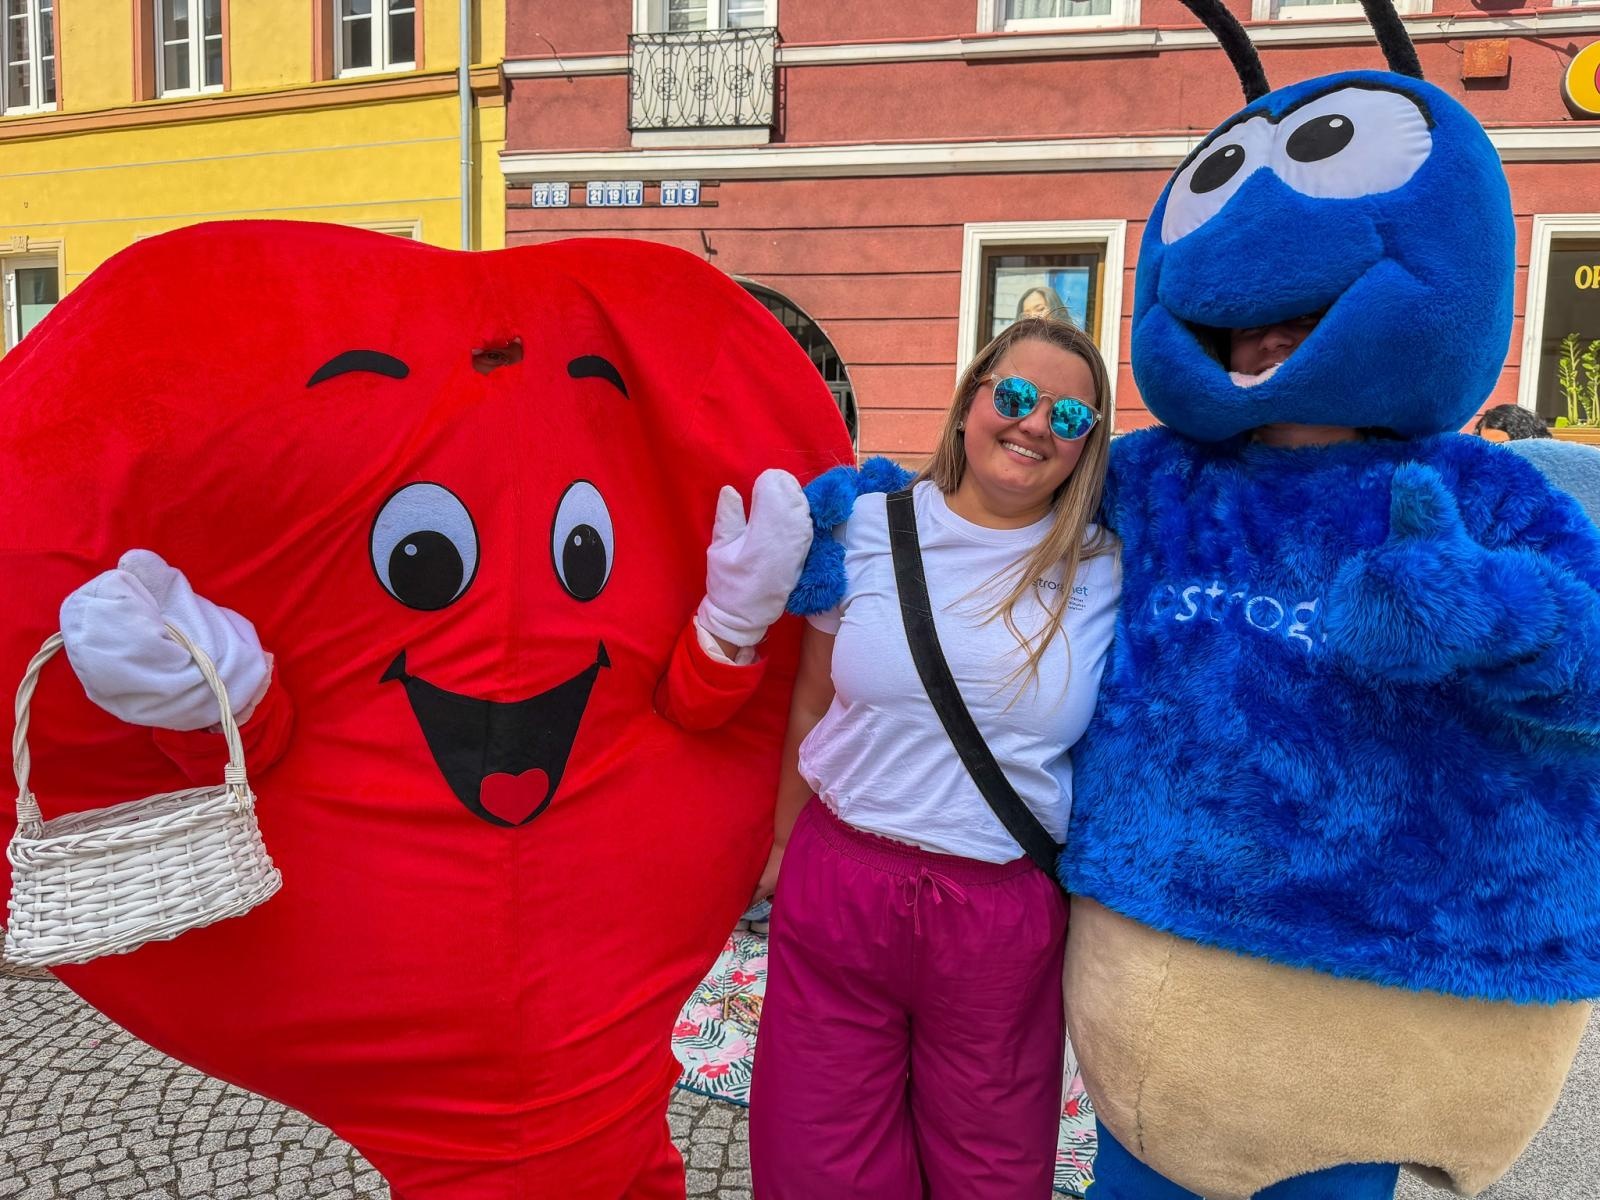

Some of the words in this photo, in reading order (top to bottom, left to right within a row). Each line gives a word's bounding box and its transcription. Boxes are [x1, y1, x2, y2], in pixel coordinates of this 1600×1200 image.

[535, 191, 549, 202] 27
[553, 191, 566, 202] 25
[590, 190, 602, 201] 21
[608, 190, 620, 201] 19
[626, 190, 639, 201] 17
[665, 190, 675, 201] 11
[684, 190, 694, 200] 9
